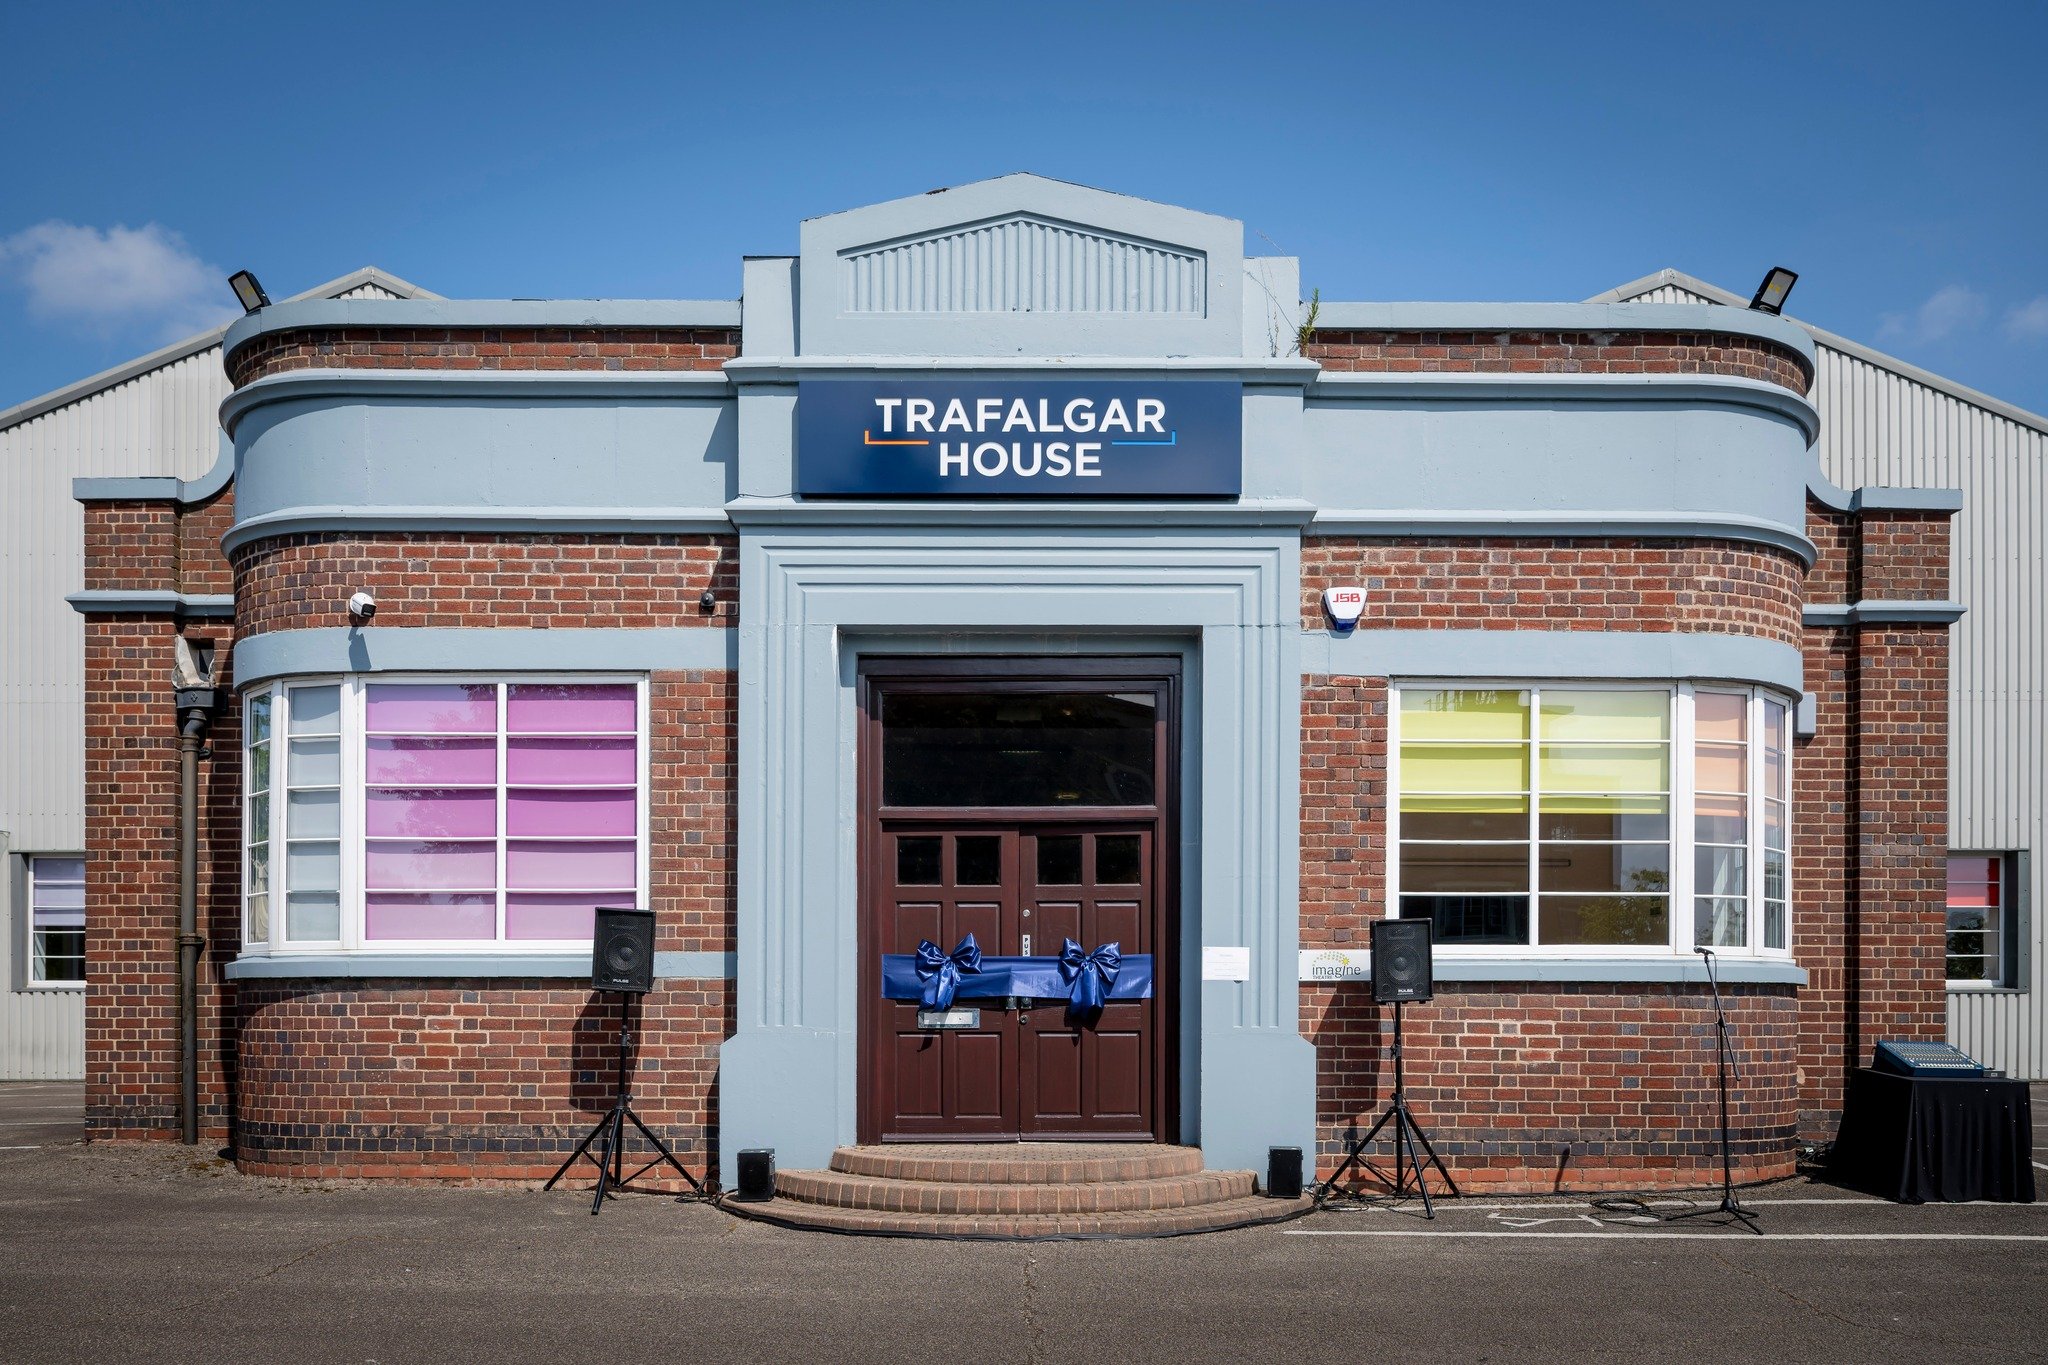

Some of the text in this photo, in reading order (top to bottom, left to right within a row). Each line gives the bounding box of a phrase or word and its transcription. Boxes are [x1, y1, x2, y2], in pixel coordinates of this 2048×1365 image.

[874, 398, 1166, 433] TRAFALGAR
[939, 442, 1102, 477] HOUSE
[1332, 593, 1361, 603] JSB
[1312, 965, 1361, 978] imagine
